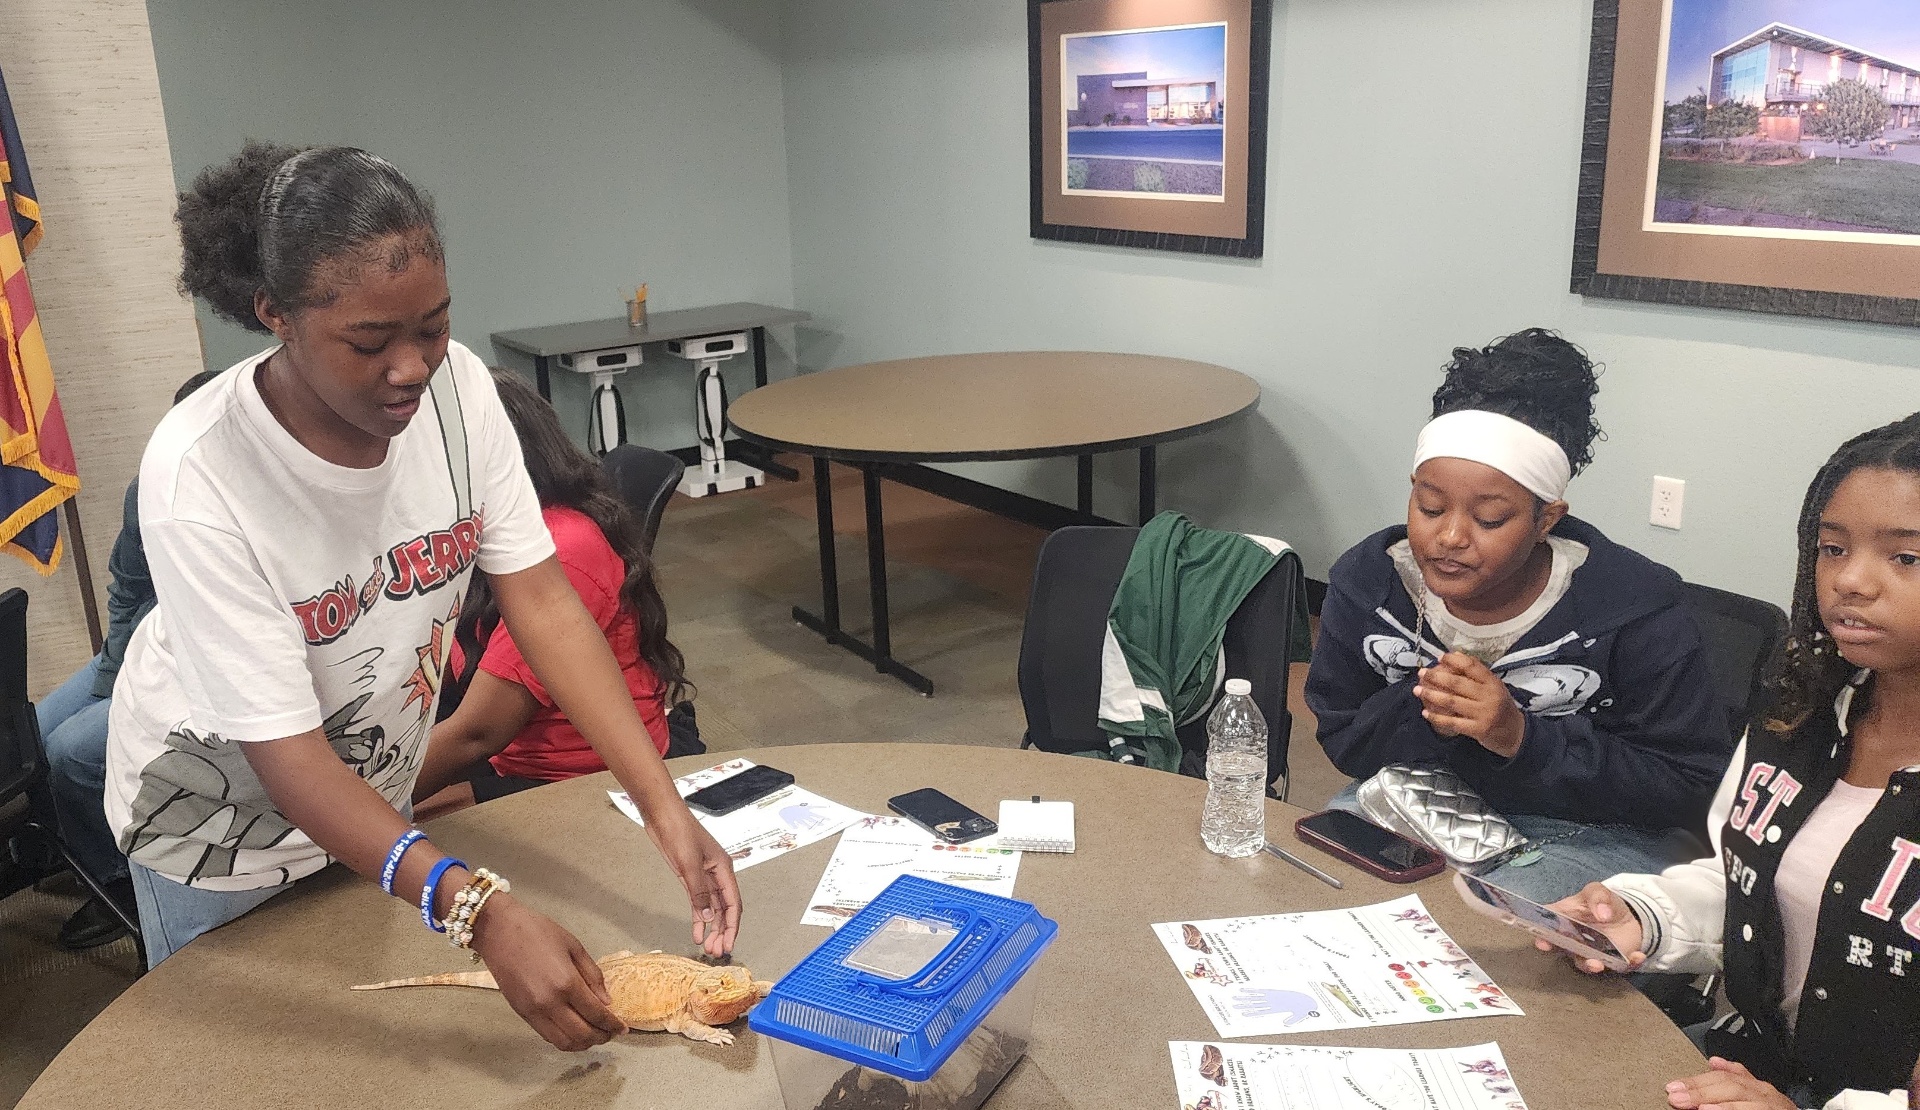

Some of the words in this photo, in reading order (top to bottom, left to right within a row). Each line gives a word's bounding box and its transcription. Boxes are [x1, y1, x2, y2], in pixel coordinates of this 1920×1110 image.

[290, 574, 361, 646] TOM
[358, 556, 385, 616] and
[384, 502, 486, 602] JERRY
